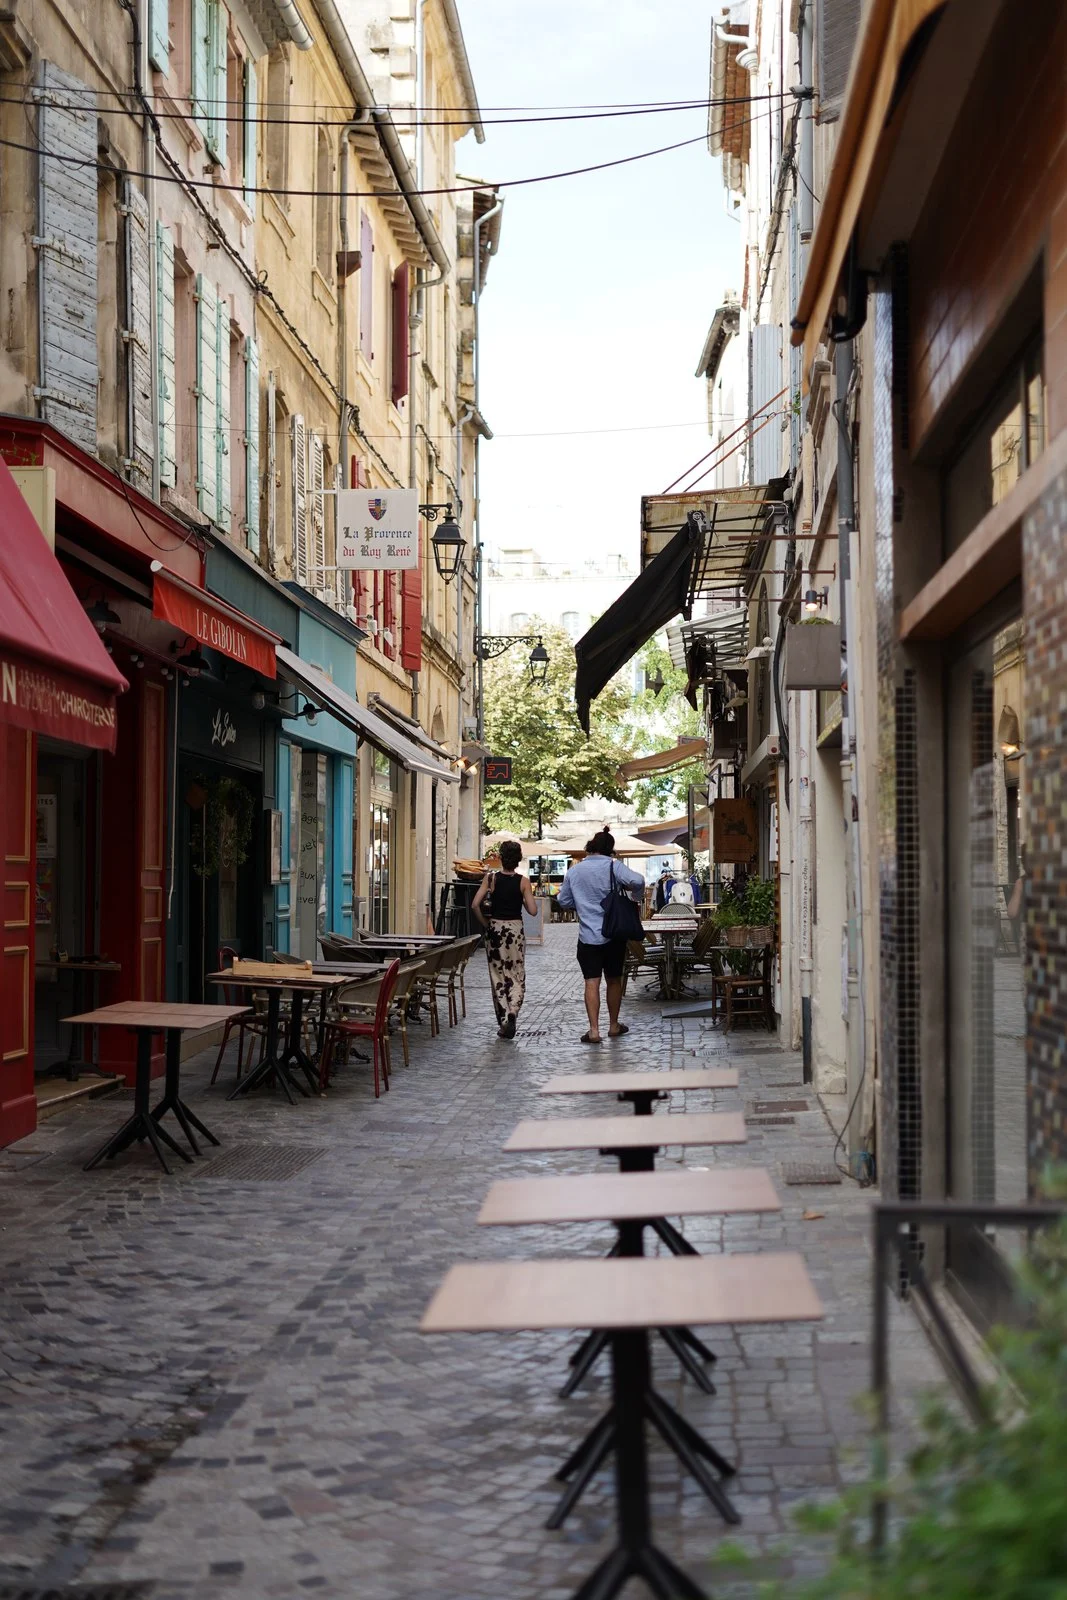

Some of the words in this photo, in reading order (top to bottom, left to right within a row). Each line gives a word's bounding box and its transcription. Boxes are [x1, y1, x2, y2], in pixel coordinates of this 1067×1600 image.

[343, 526, 359, 539] La
[364, 526, 413, 542] Provence
[343, 546, 355, 557] du
[361, 545, 382, 560] Roy
[387, 545, 411, 557] René
[196, 609, 209, 641] LE
[210, 616, 248, 661] GIBOLIN
